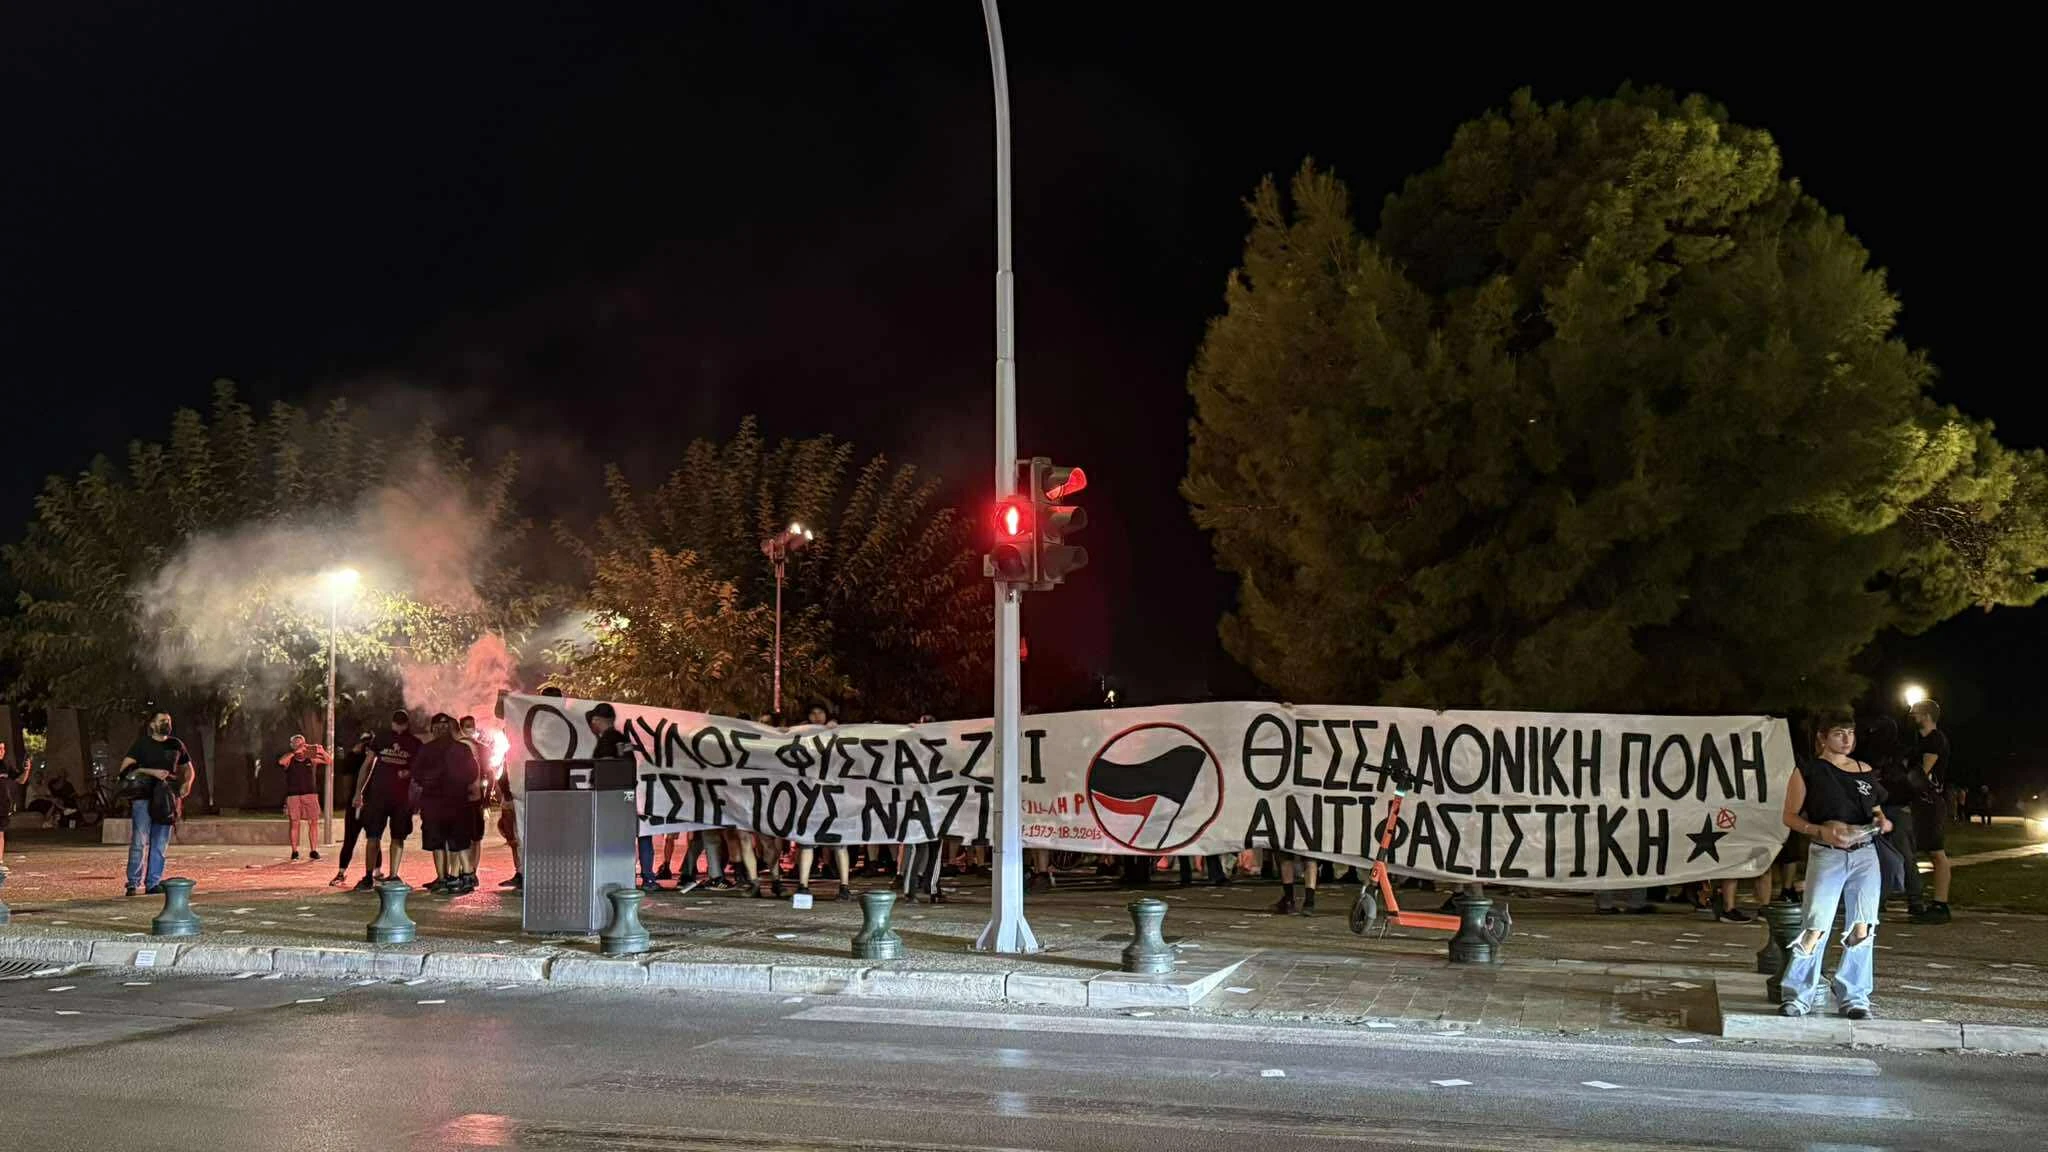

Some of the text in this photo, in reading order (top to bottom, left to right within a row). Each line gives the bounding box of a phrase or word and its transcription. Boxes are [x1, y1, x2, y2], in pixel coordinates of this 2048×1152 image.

[623, 715, 768, 769] ΑΥΛΟΣ
[776, 734, 954, 785] ΦΥΣΣΑΣ
[1242, 713, 1767, 803] ΘΕΣΣΑΛΟΝΙΚΗ ΠΟΛΗ
[741, 777, 845, 843] ΤΟΥΣ
[861, 785, 994, 846] ΝΑΖΙ
[1244, 794, 1669, 878] ΑΝΤΙΦΑΣΙΣΤΙΚΗ
